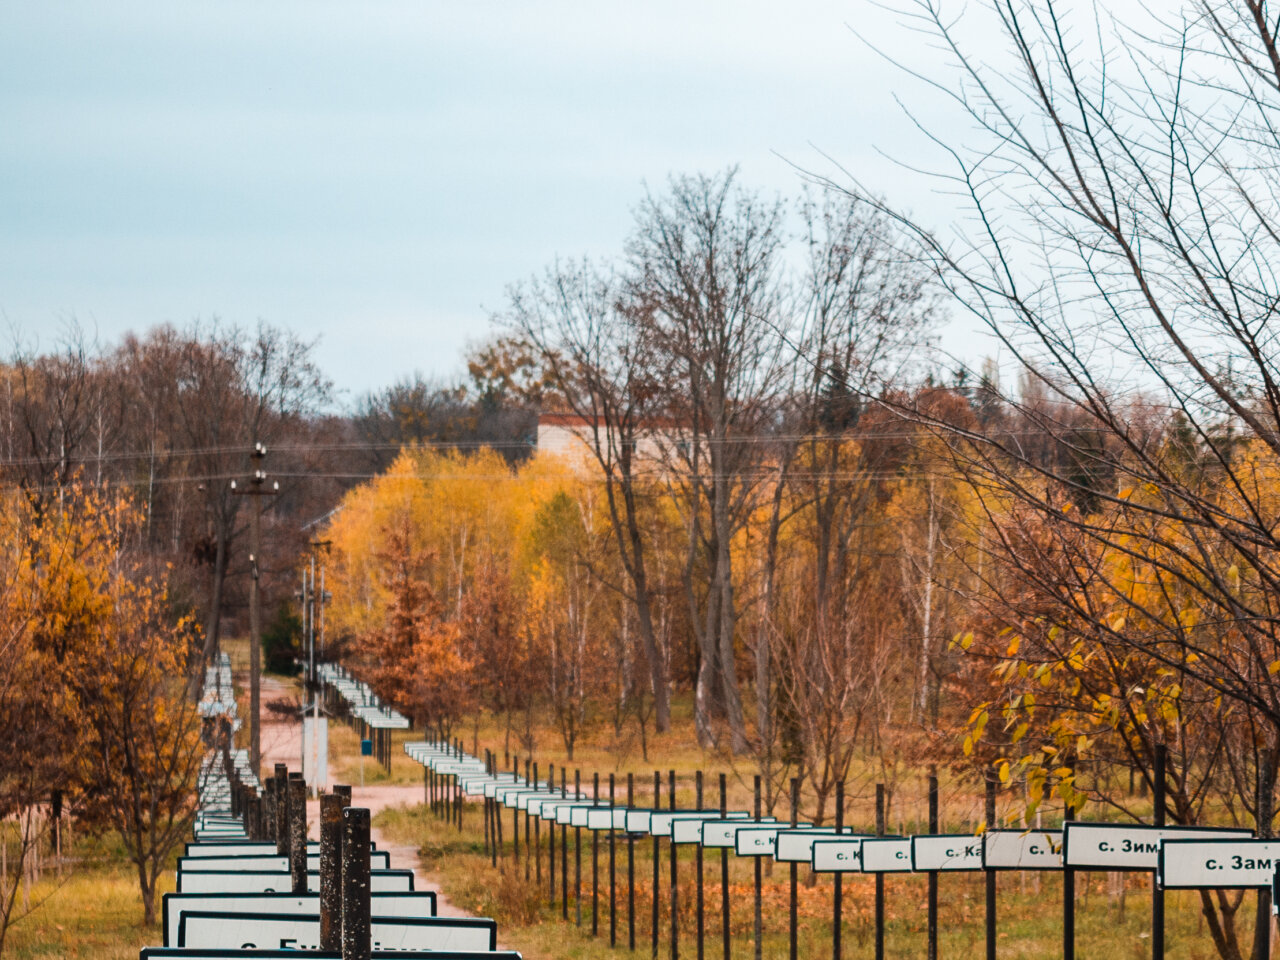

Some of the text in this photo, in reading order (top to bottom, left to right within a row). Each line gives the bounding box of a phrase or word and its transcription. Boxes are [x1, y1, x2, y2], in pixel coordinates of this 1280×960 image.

[1029, 845, 1044, 855] с.
[1098, 841, 1115, 852] с.
[1205, 859, 1223, 870] с.
